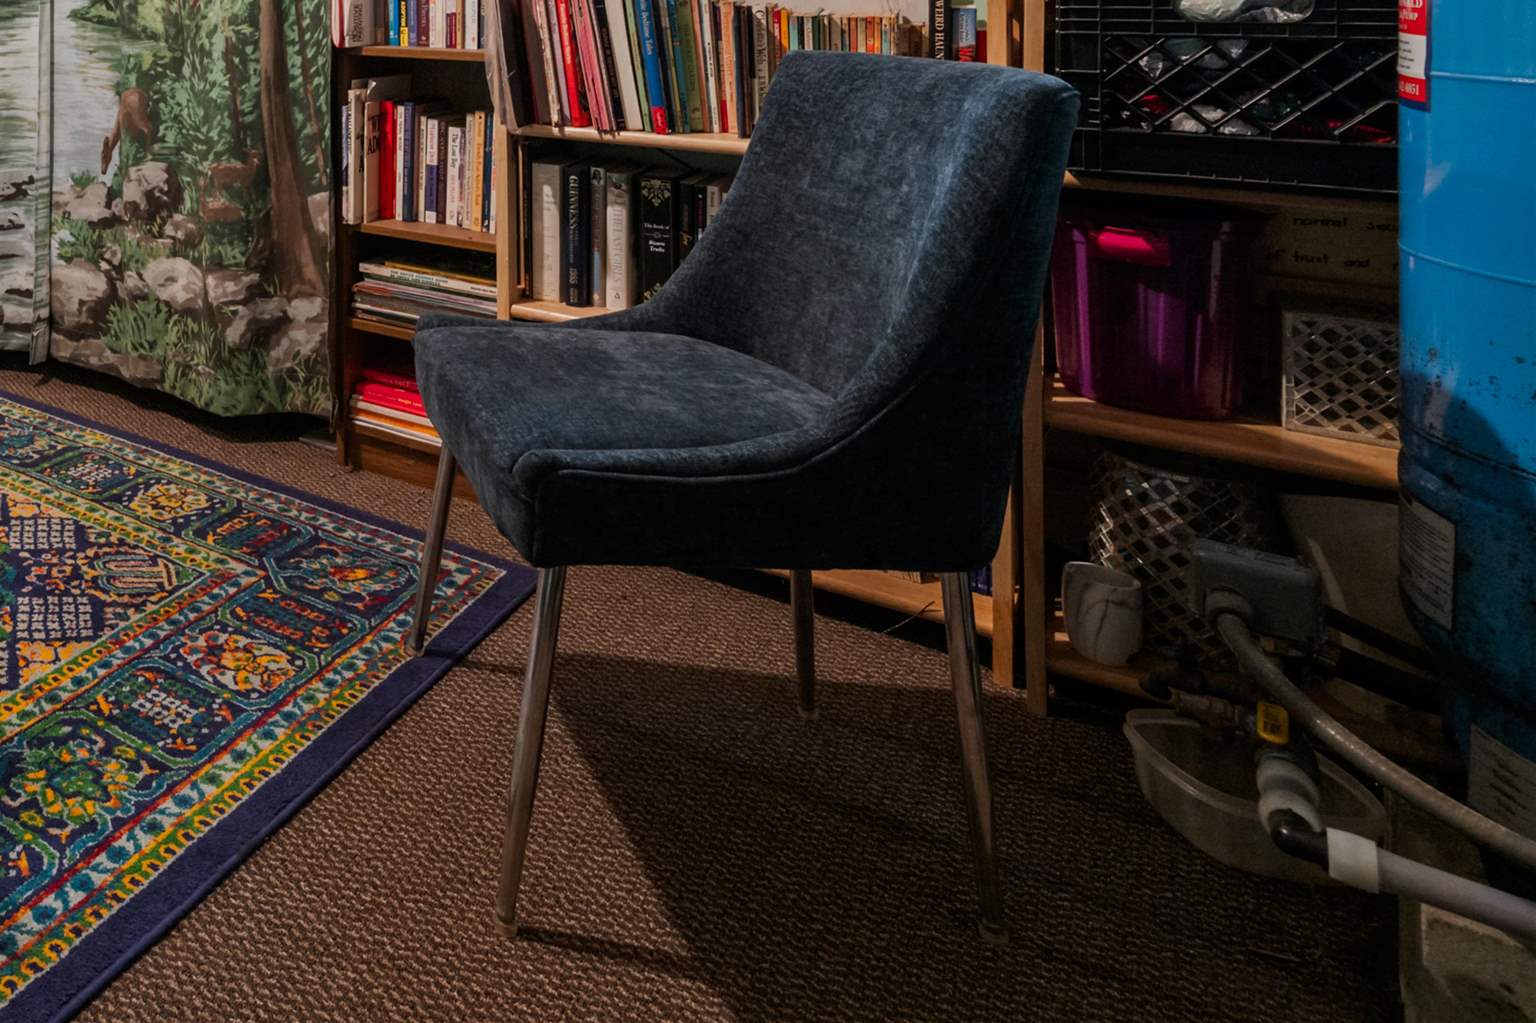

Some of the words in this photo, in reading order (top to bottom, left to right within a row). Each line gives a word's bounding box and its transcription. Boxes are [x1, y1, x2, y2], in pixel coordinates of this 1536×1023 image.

[641, 11, 651, 38] Bedtime
[646, 39, 654, 55] Tales
[935, 0, 944, 31] WEIRD
[450, 158, 458, 169] Boy
[569, 175, 579, 229] GUINNESS
